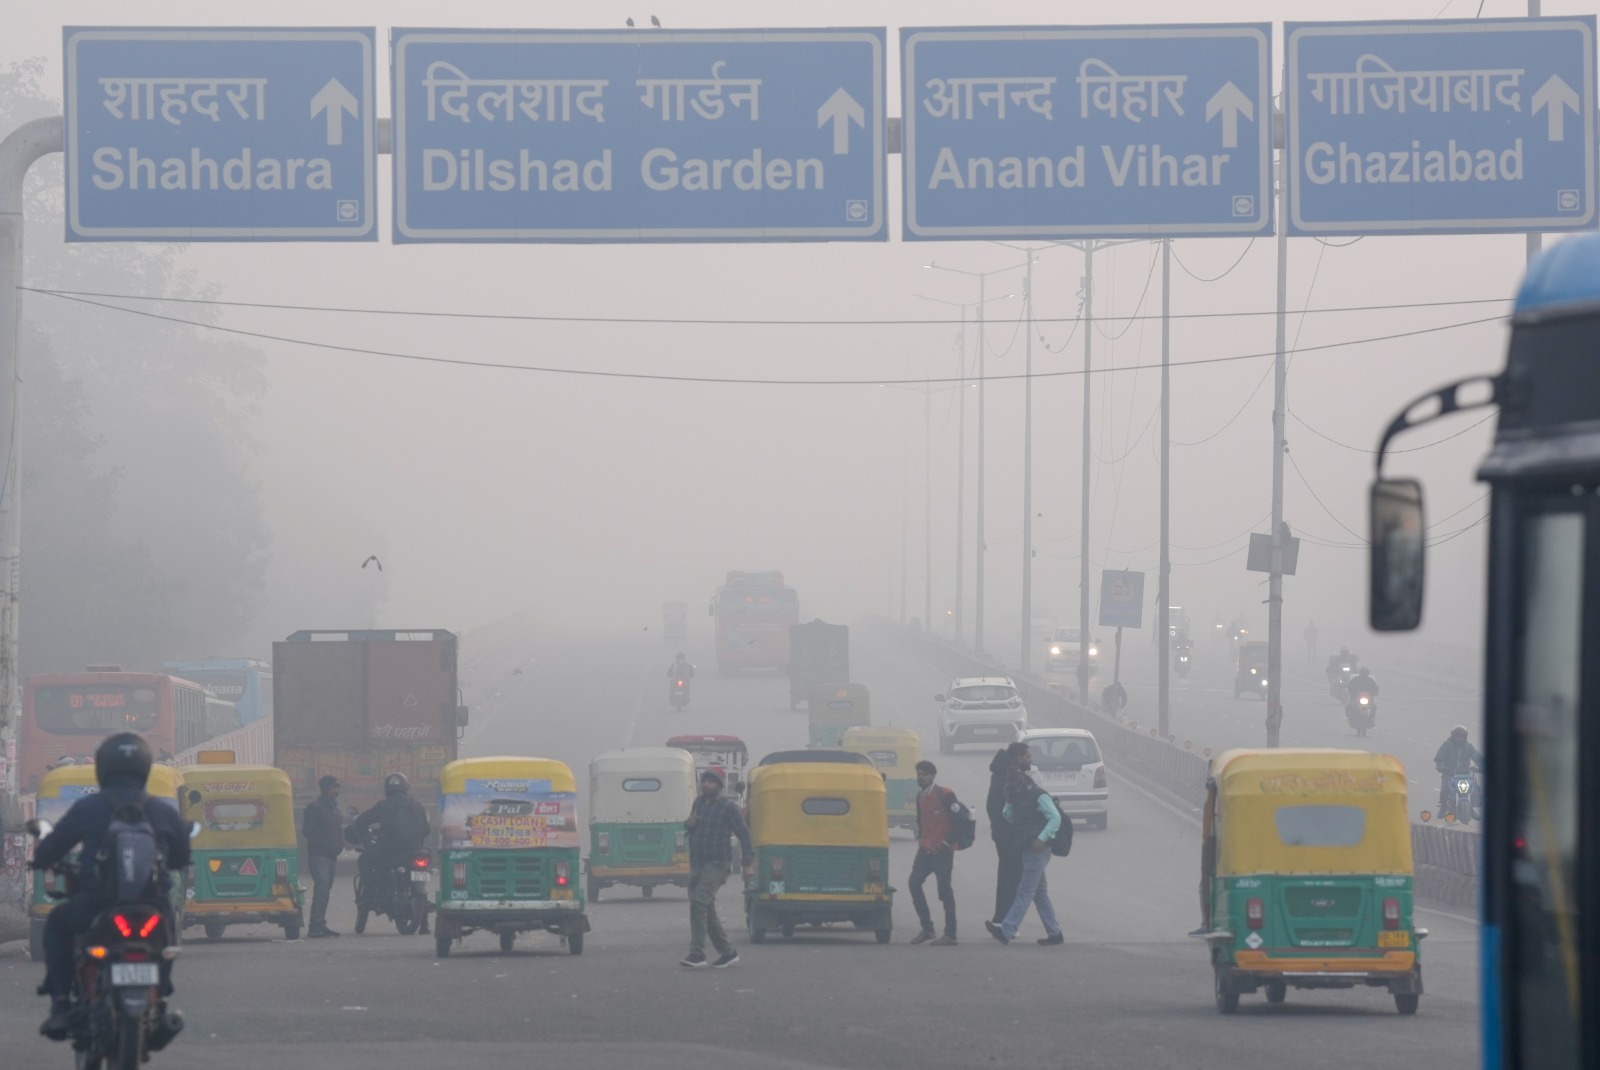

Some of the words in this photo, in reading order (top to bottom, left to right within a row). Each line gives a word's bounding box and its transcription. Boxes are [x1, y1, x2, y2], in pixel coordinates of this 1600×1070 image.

[99, 77, 268, 125] शाहदरा
[422, 61, 609, 123] दिलशाद
[636, 61, 762, 122] गार्डन
[923, 76, 1056, 120] आनन्द
[1076, 57, 1188, 123] विहार
[1307, 54, 1525, 116] गाजियाबाद
[91, 147, 333, 191] Shahdara
[422, 148, 612, 192] Dilshad
[641, 148, 825, 192] Garden
[928, 145, 1086, 190] Anand
[1100, 144, 1231, 188] Vihar
[1304, 139, 1524, 185] Ghaziabad
[480, 817, 507, 826] CASH
[510, 817, 540, 826] LOAN
